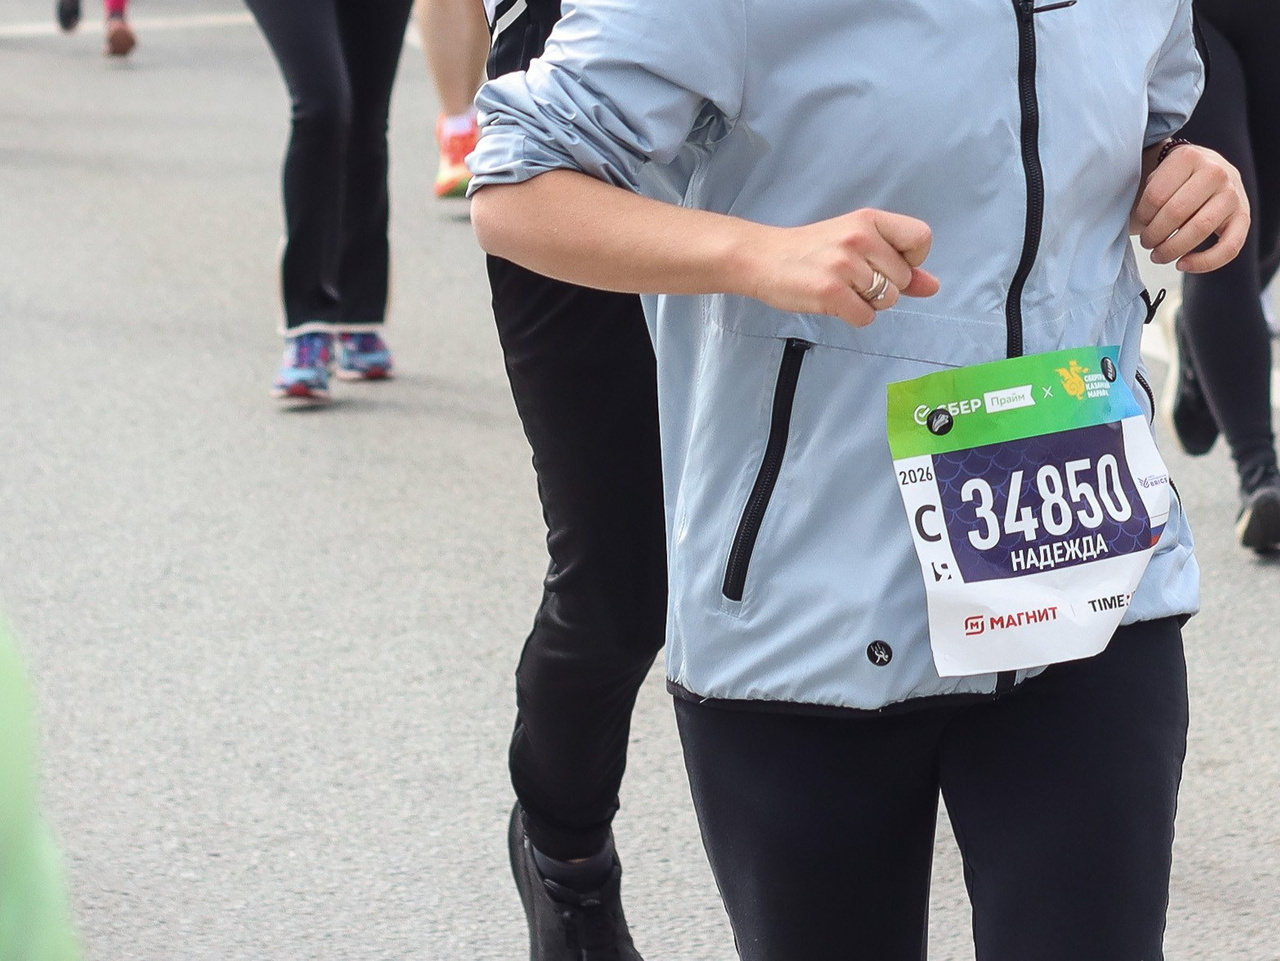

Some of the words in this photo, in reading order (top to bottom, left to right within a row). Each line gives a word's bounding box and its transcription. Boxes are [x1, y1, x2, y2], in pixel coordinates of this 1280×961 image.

[991, 393, 1026, 407] Прайм
[899, 467, 933, 486] 2026
[961, 453, 1132, 551] 34850
[1010, 533, 1109, 572] НАДЕЖДА
[990, 606, 1058, 630] МАГНИТ
